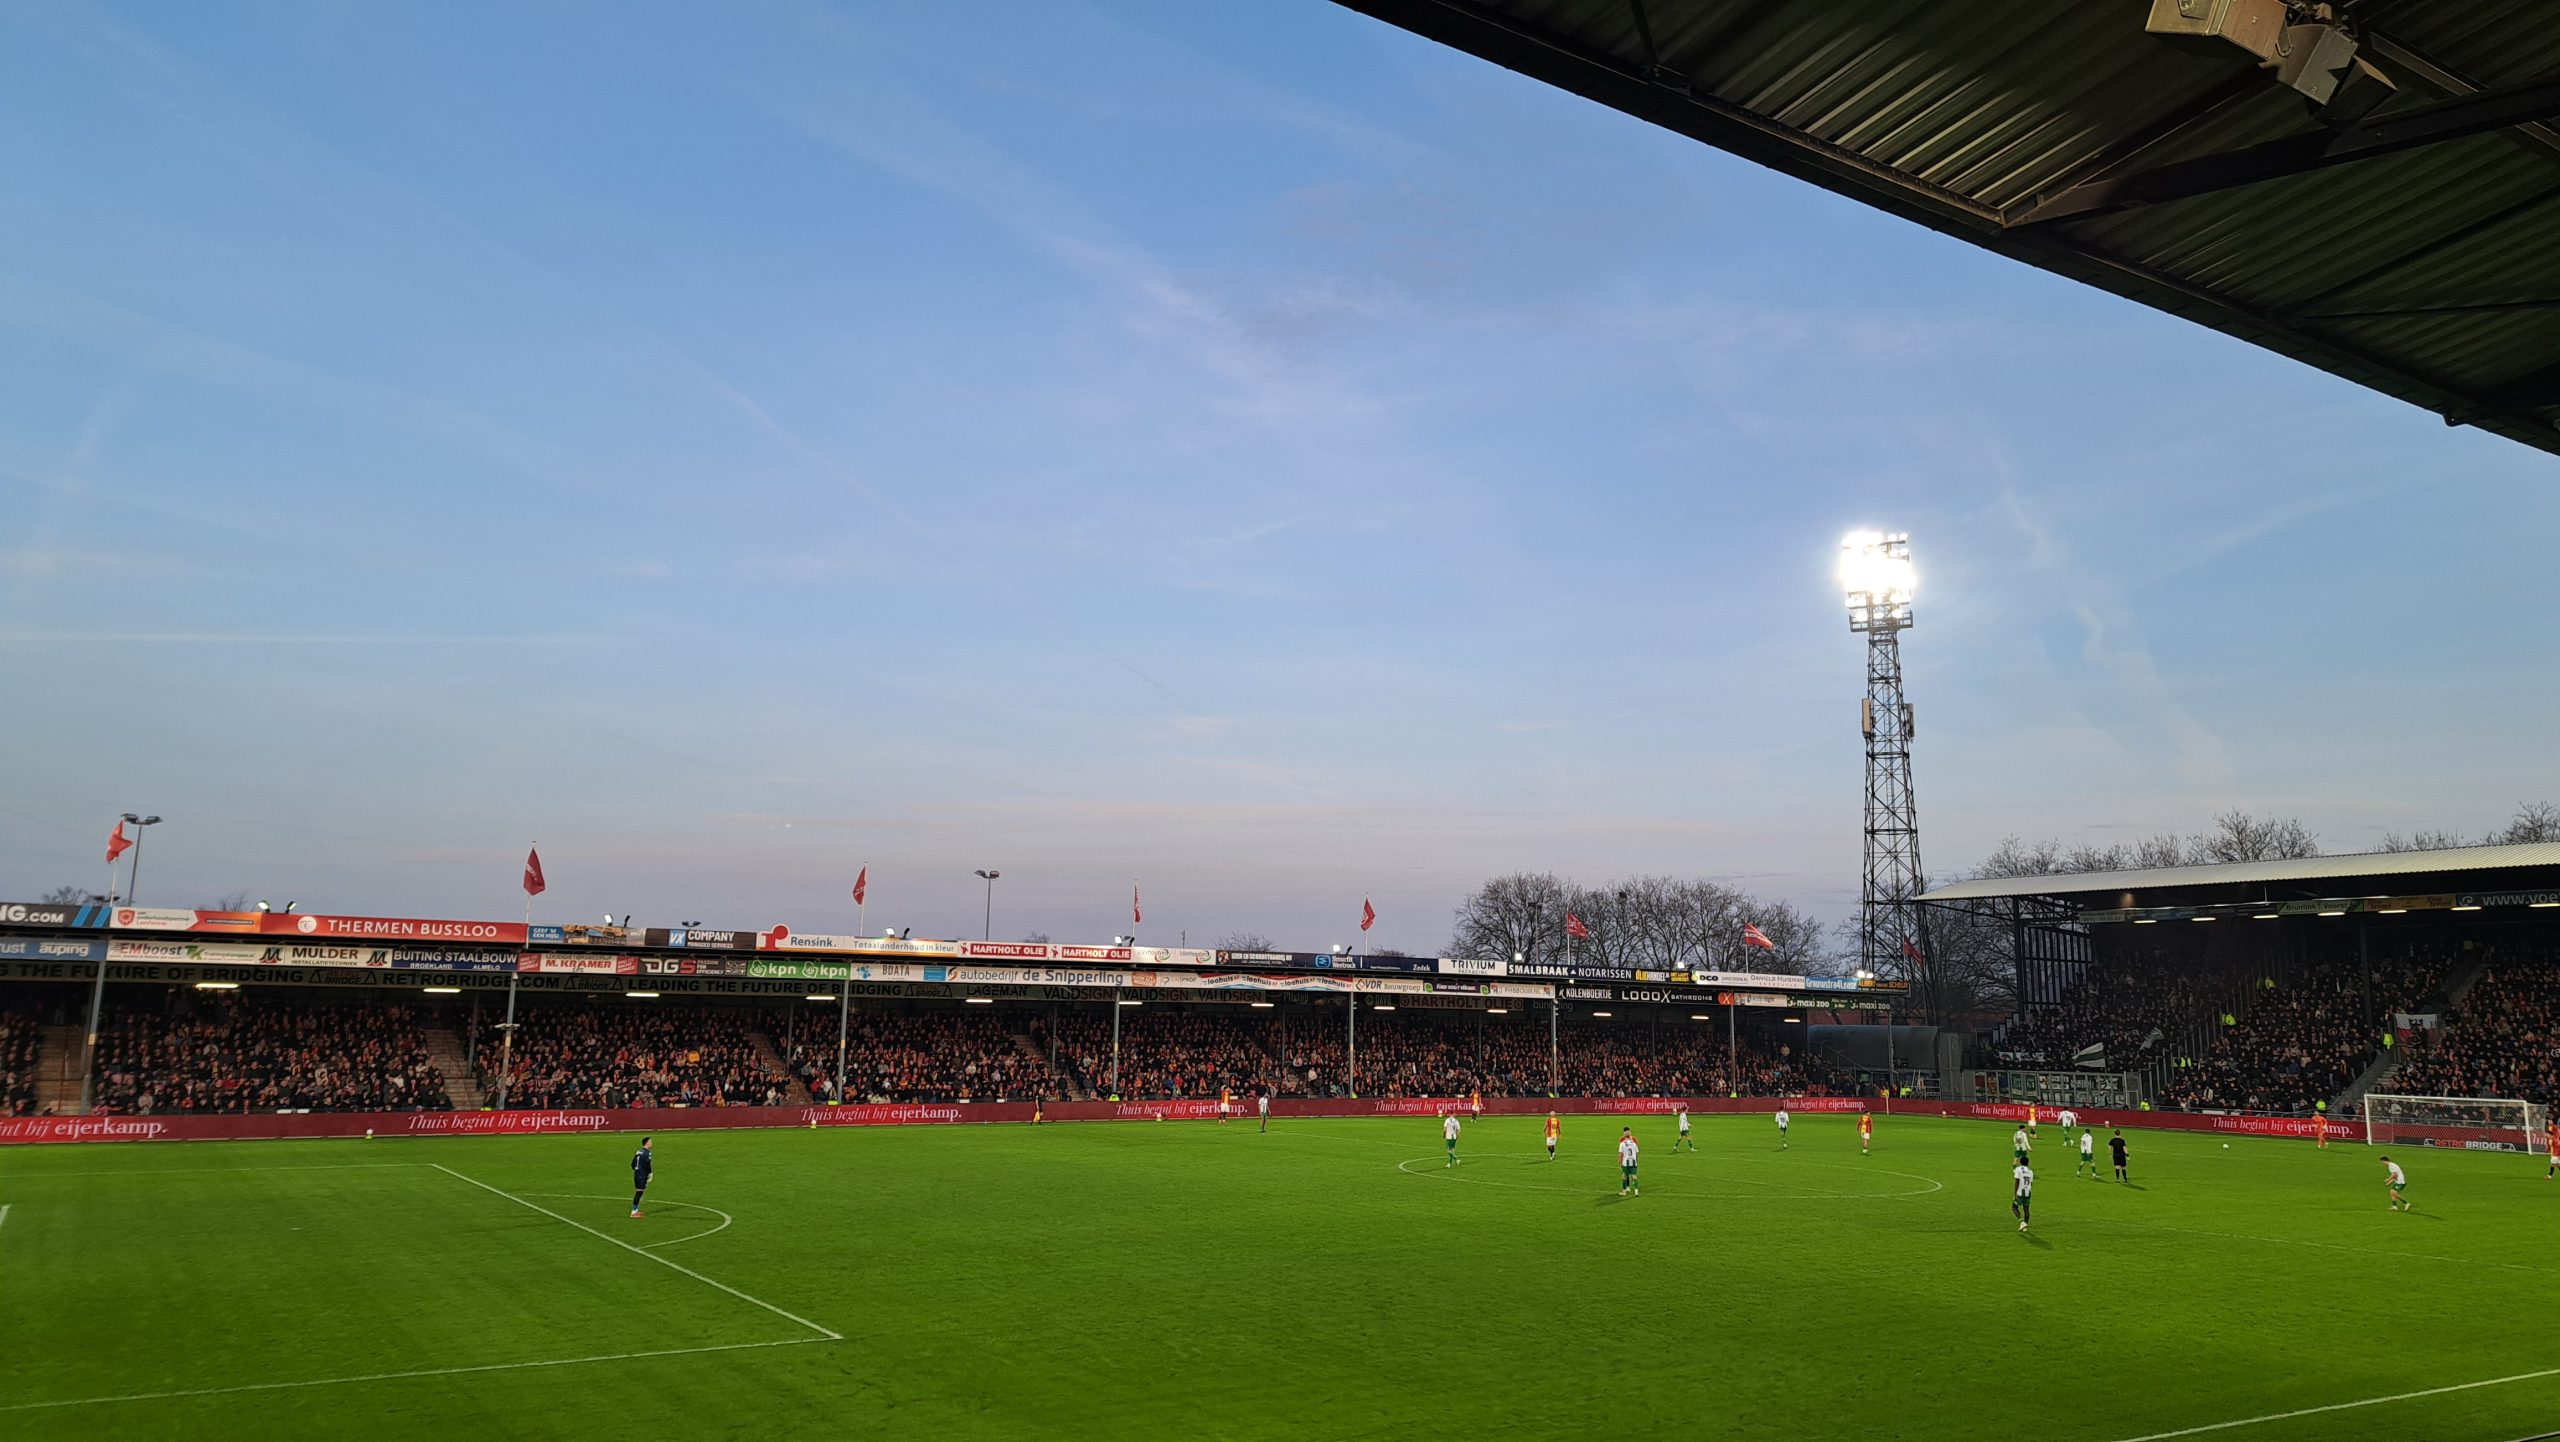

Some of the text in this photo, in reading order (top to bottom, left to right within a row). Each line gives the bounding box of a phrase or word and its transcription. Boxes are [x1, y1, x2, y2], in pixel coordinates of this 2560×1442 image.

[328, 919, 497, 938] THERMEN BUSSLOO
[670, 933, 685, 945] VX
[687, 931, 735, 942] COMPANY
[39, 942, 89, 957] auping
[120, 942, 182, 956] EMboost
[291, 948, 360, 960] MULDER
[972, 943, 1045, 956] HARTHOLT OLIE
[1062, 947, 1131, 959] HARTHOLT OLIE
[394, 950, 442, 964] BUITING
[445, 952, 518, 965] STAALBOUW
[545, 959, 559, 968] M.
[561, 959, 611, 969] KRAMER
[1451, 959, 1496, 971] TRIVIUM
[17, 963, 64, 979] THE
[167, 966, 195, 981] OF
[202, 967, 305, 984] BRIDGING
[768, 963, 797, 980] kpn
[820, 964, 848, 982] kpn
[882, 964, 910, 977] BDATA
[1022, 968, 1043, 982] de
[1045, 969, 1124, 985] Snipperling
[1508, 964, 1632, 980] SMALBRAAK NOTARISSEN
[628, 979, 701, 992] LEADING
[705, 981, 739, 993] THE
[742, 982, 804, 996] FUTURE
[807, 984, 828, 996] OF
[1365, 979, 1422, 993] VDR Bouwgroep
[1043, 987, 1114, 1002] VALIDSIGN
[1120, 988, 1191, 1003] VALIDSIGN
[1198, 989, 1263, 1004] VALIDSIGN
[1411, 995, 1512, 1010] HARTHOLT OLIE
[1796, 999, 1830, 1009] maxi zoo
[1859, 1001, 1891, 1010] maxi zoo
[800, 1104, 963, 1123] Thuis begint bij eijerkamp.
[1115, 1103, 1142, 1117] Thuis
[1173, 1101, 1188, 1117] bij
[1189, 1101, 1248, 1116] eijerkmp.
[1374, 1100, 1396, 1112] Thuis
[1398, 1099, 1424, 1114] begint
[1424, 1099, 1435, 1113] bij
[1593, 1099, 1689, 1113] Thuis begint bij eijerkamp.
[1783, 1099, 1798, 1111] Thuis
[1828, 1099, 1866, 1113] eijerkamp.
[1970, 1104, 1991, 1116] Thuis
[1992, 1106, 2016, 1119] begint
[24, 1118, 51, 1137] bij
[54, 1116, 169, 1139] eijerkamp.
[407, 1110, 610, 1131] Thuis begint bij eijerkamp.
[2210, 1116, 2238, 1129] Thuis
[2239, 1118, 2269, 1132] begint
[2271, 1119, 2285, 1133] bij
[2465, 1139, 2504, 1150] BRIDGE
